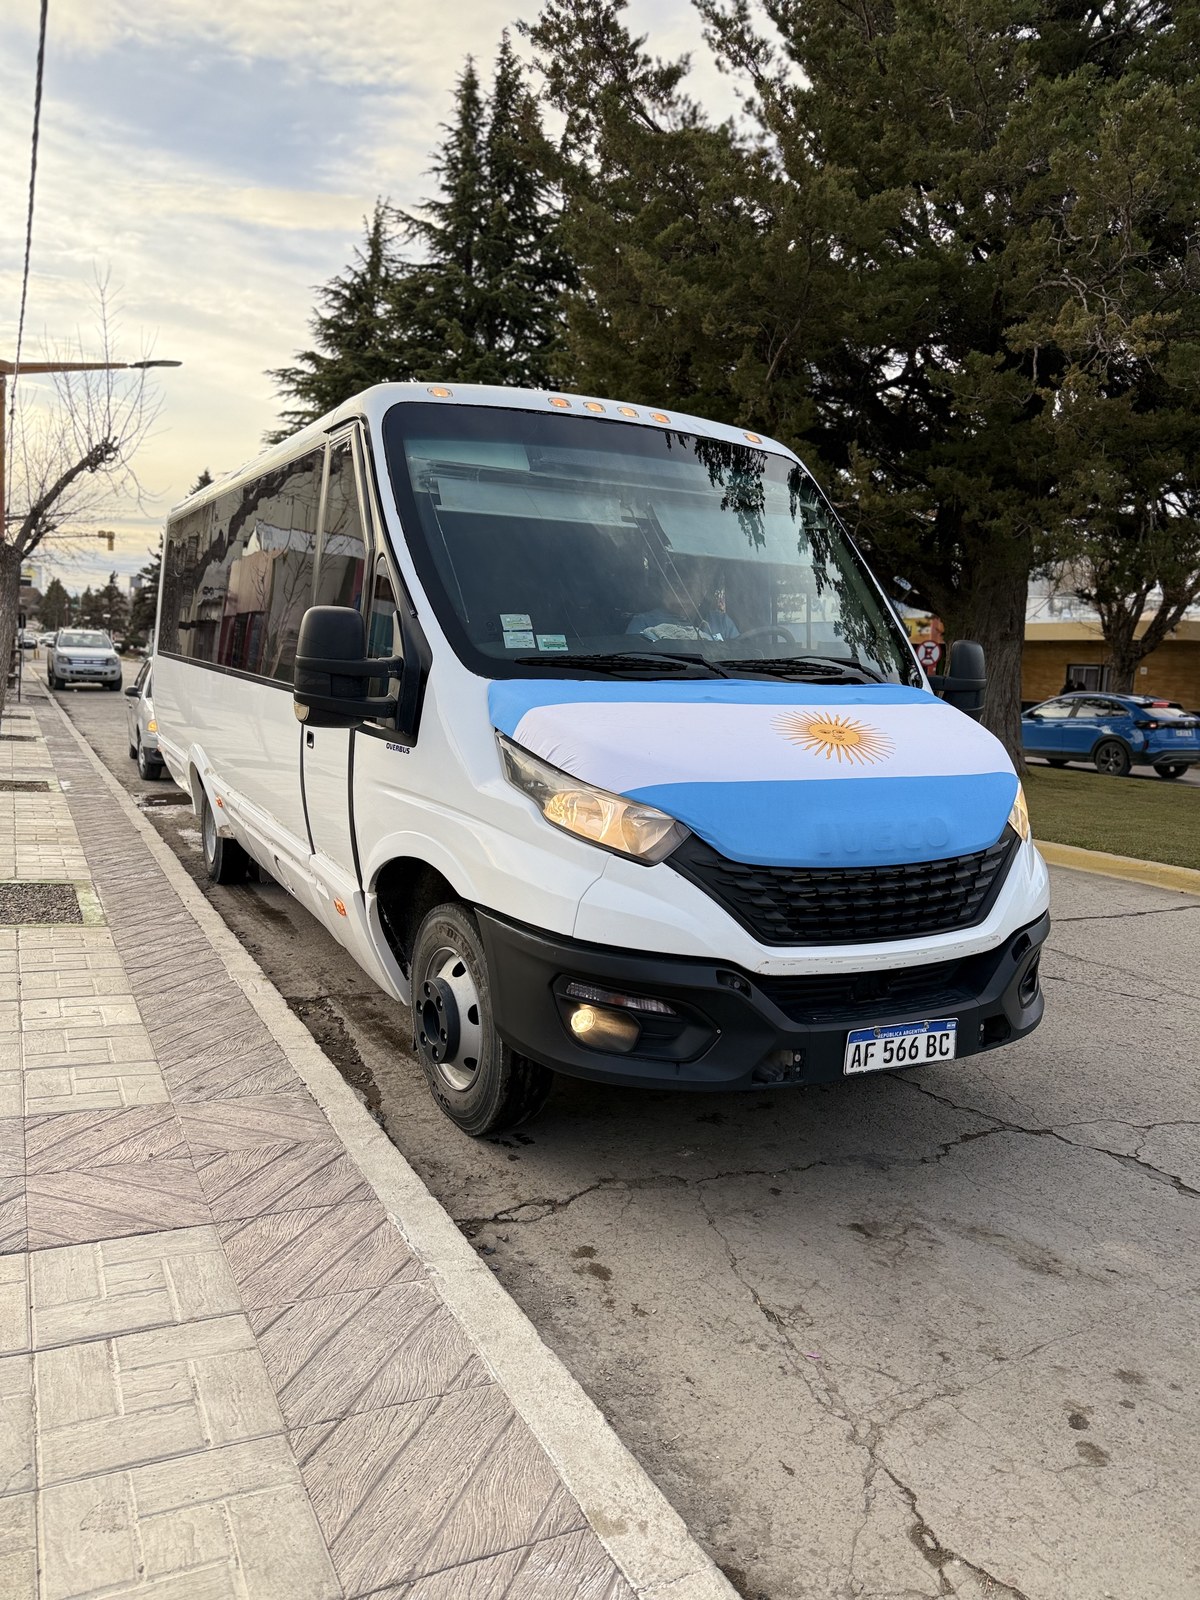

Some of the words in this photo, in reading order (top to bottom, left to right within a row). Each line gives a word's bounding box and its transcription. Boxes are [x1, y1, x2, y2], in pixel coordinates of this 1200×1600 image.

[903, 1028, 928, 1036] ARGENTINA
[851, 1042, 876, 1068] AF
[883, 1036, 919, 1064] 566
[926, 1033, 950, 1058] BC
